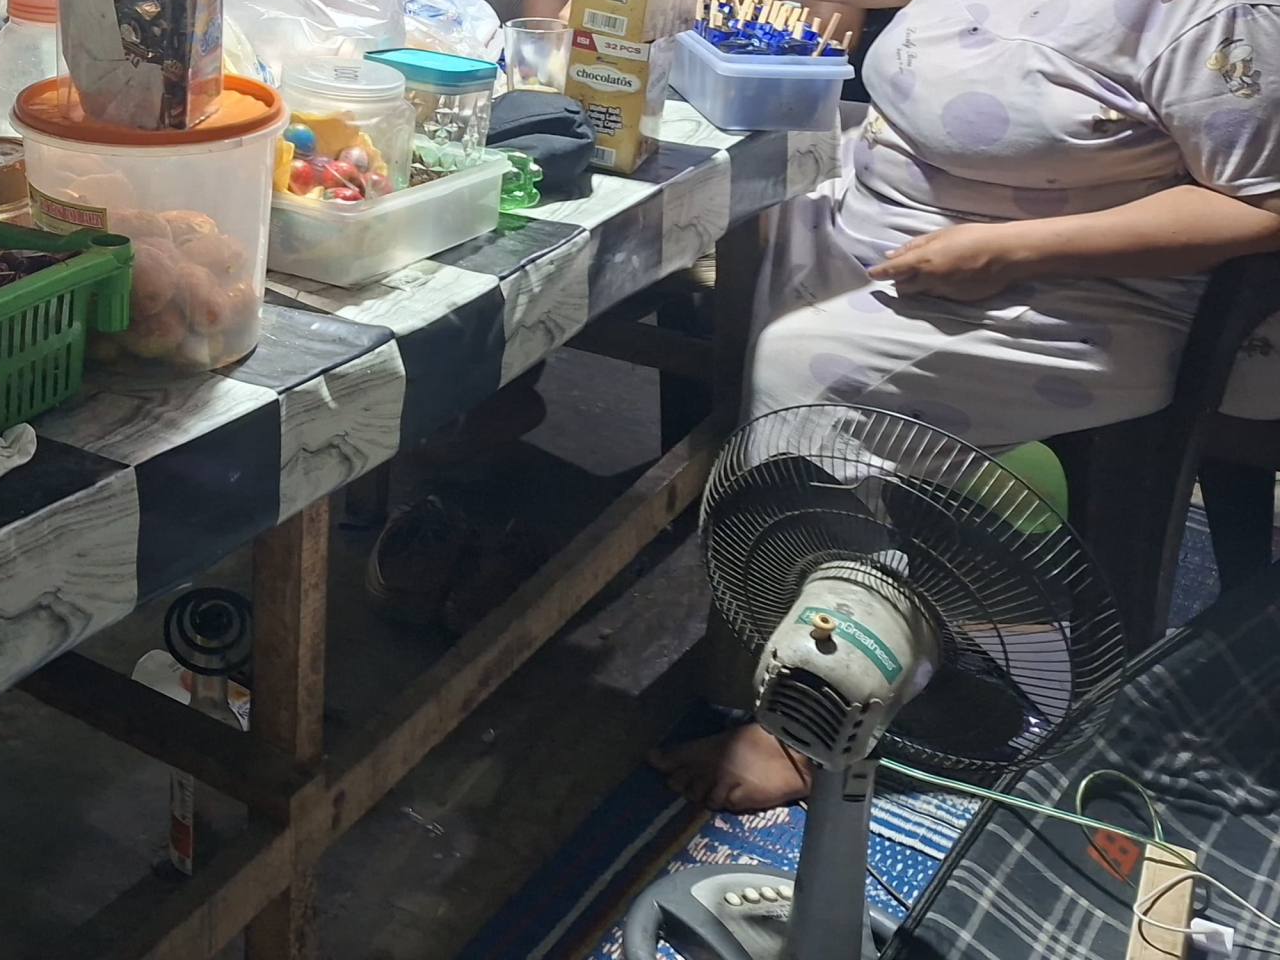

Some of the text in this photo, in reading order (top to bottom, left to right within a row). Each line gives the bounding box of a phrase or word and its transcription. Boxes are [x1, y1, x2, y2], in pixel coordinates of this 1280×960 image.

[576, 36, 642, 54] ISI 32 PCS
[803, 609, 896, 671] HnGreatness
